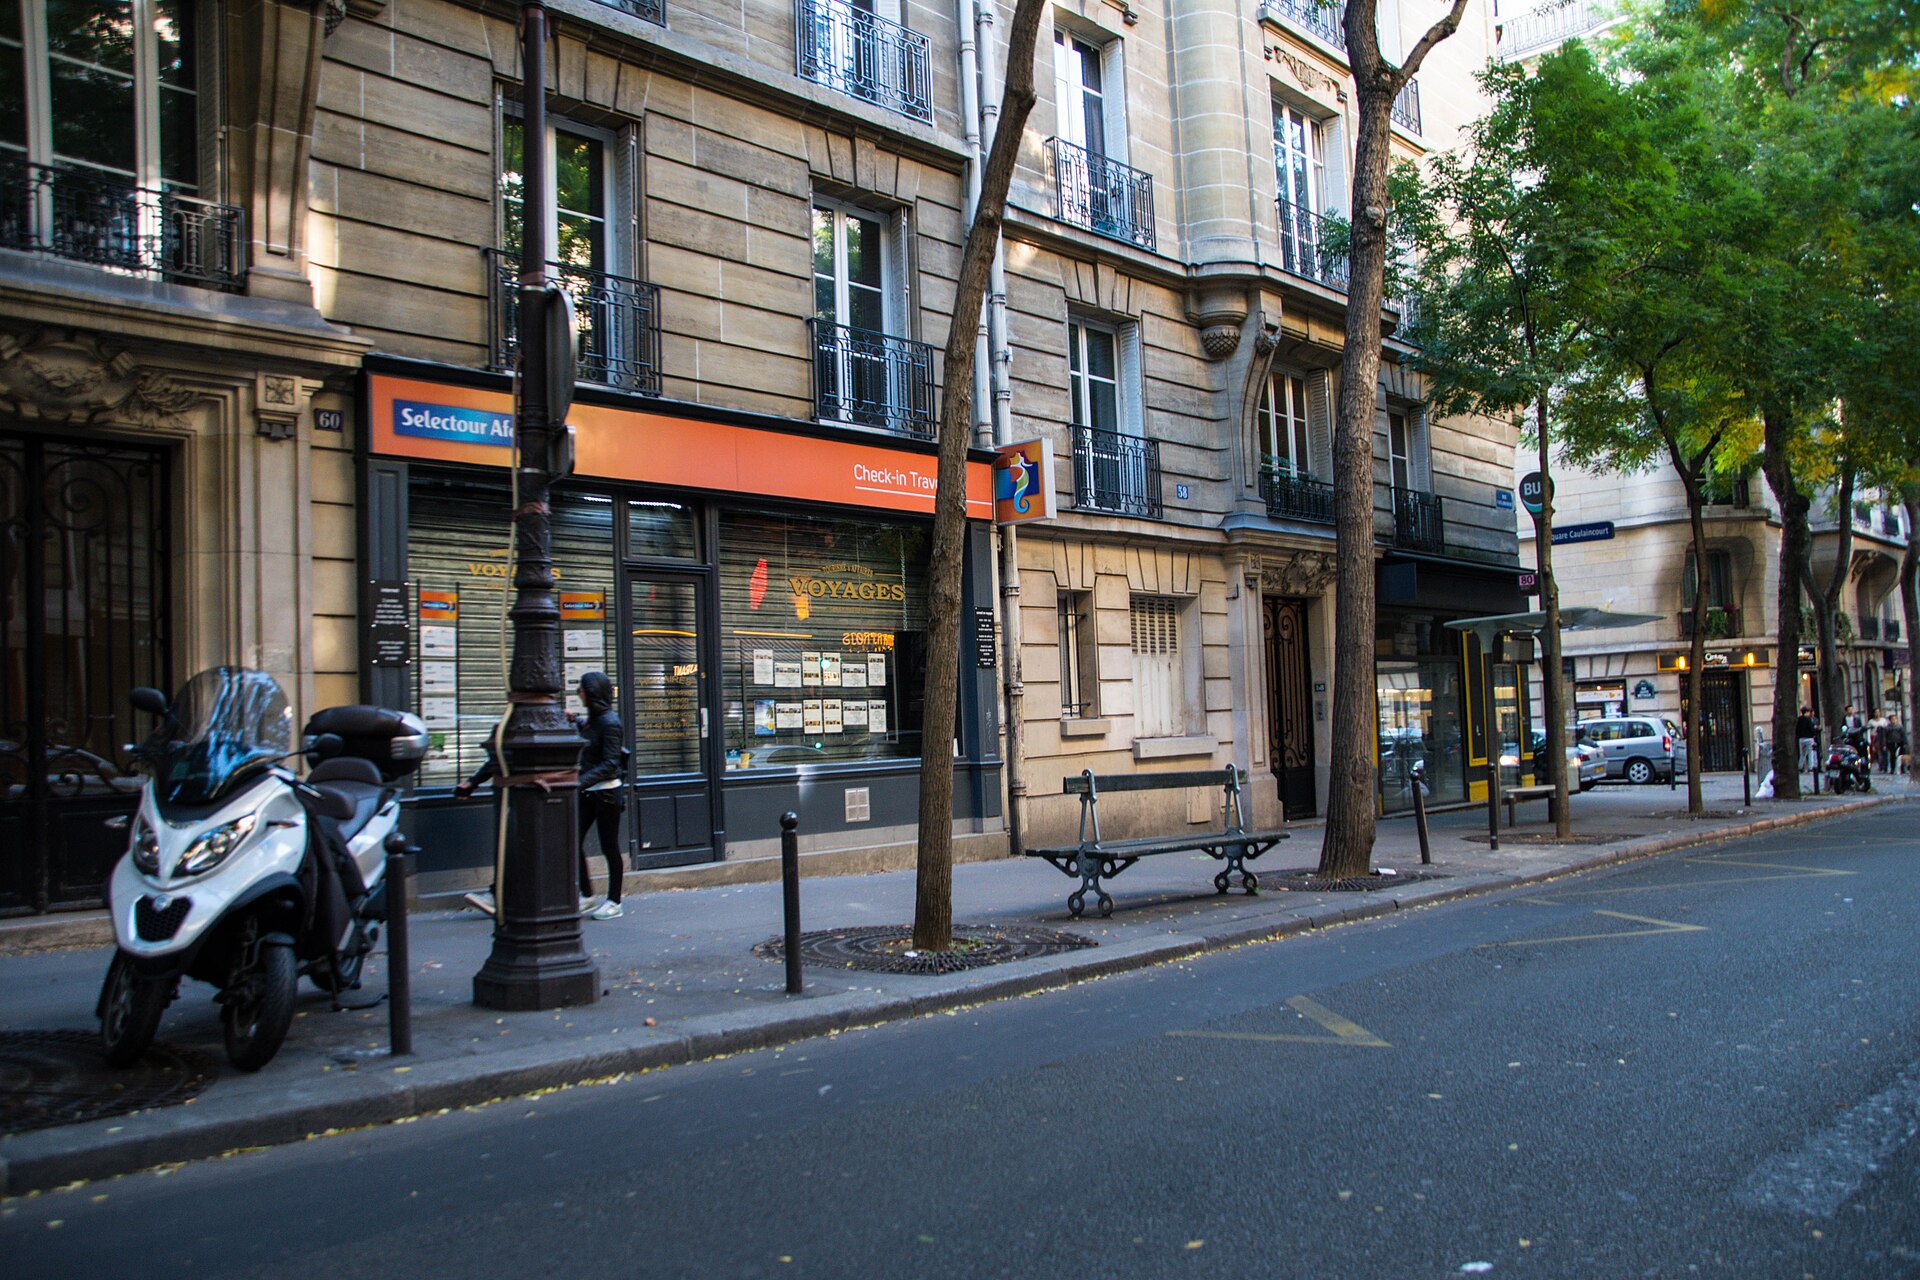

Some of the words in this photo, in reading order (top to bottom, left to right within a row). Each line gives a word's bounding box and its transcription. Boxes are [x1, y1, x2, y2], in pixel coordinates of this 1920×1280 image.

[318, 411, 341, 429] 60
[401, 407, 488, 435] Selectour
[853, 463, 907, 487] Check-in
[1177, 485, 1188, 499] 58
[1523, 482, 1541, 496] BU
[1552, 533, 1568, 543] quare
[1569, 527, 1609, 539] Caulaincourt
[789, 576, 905, 601] VOYAGES
[1520, 575, 1533, 585] 80
